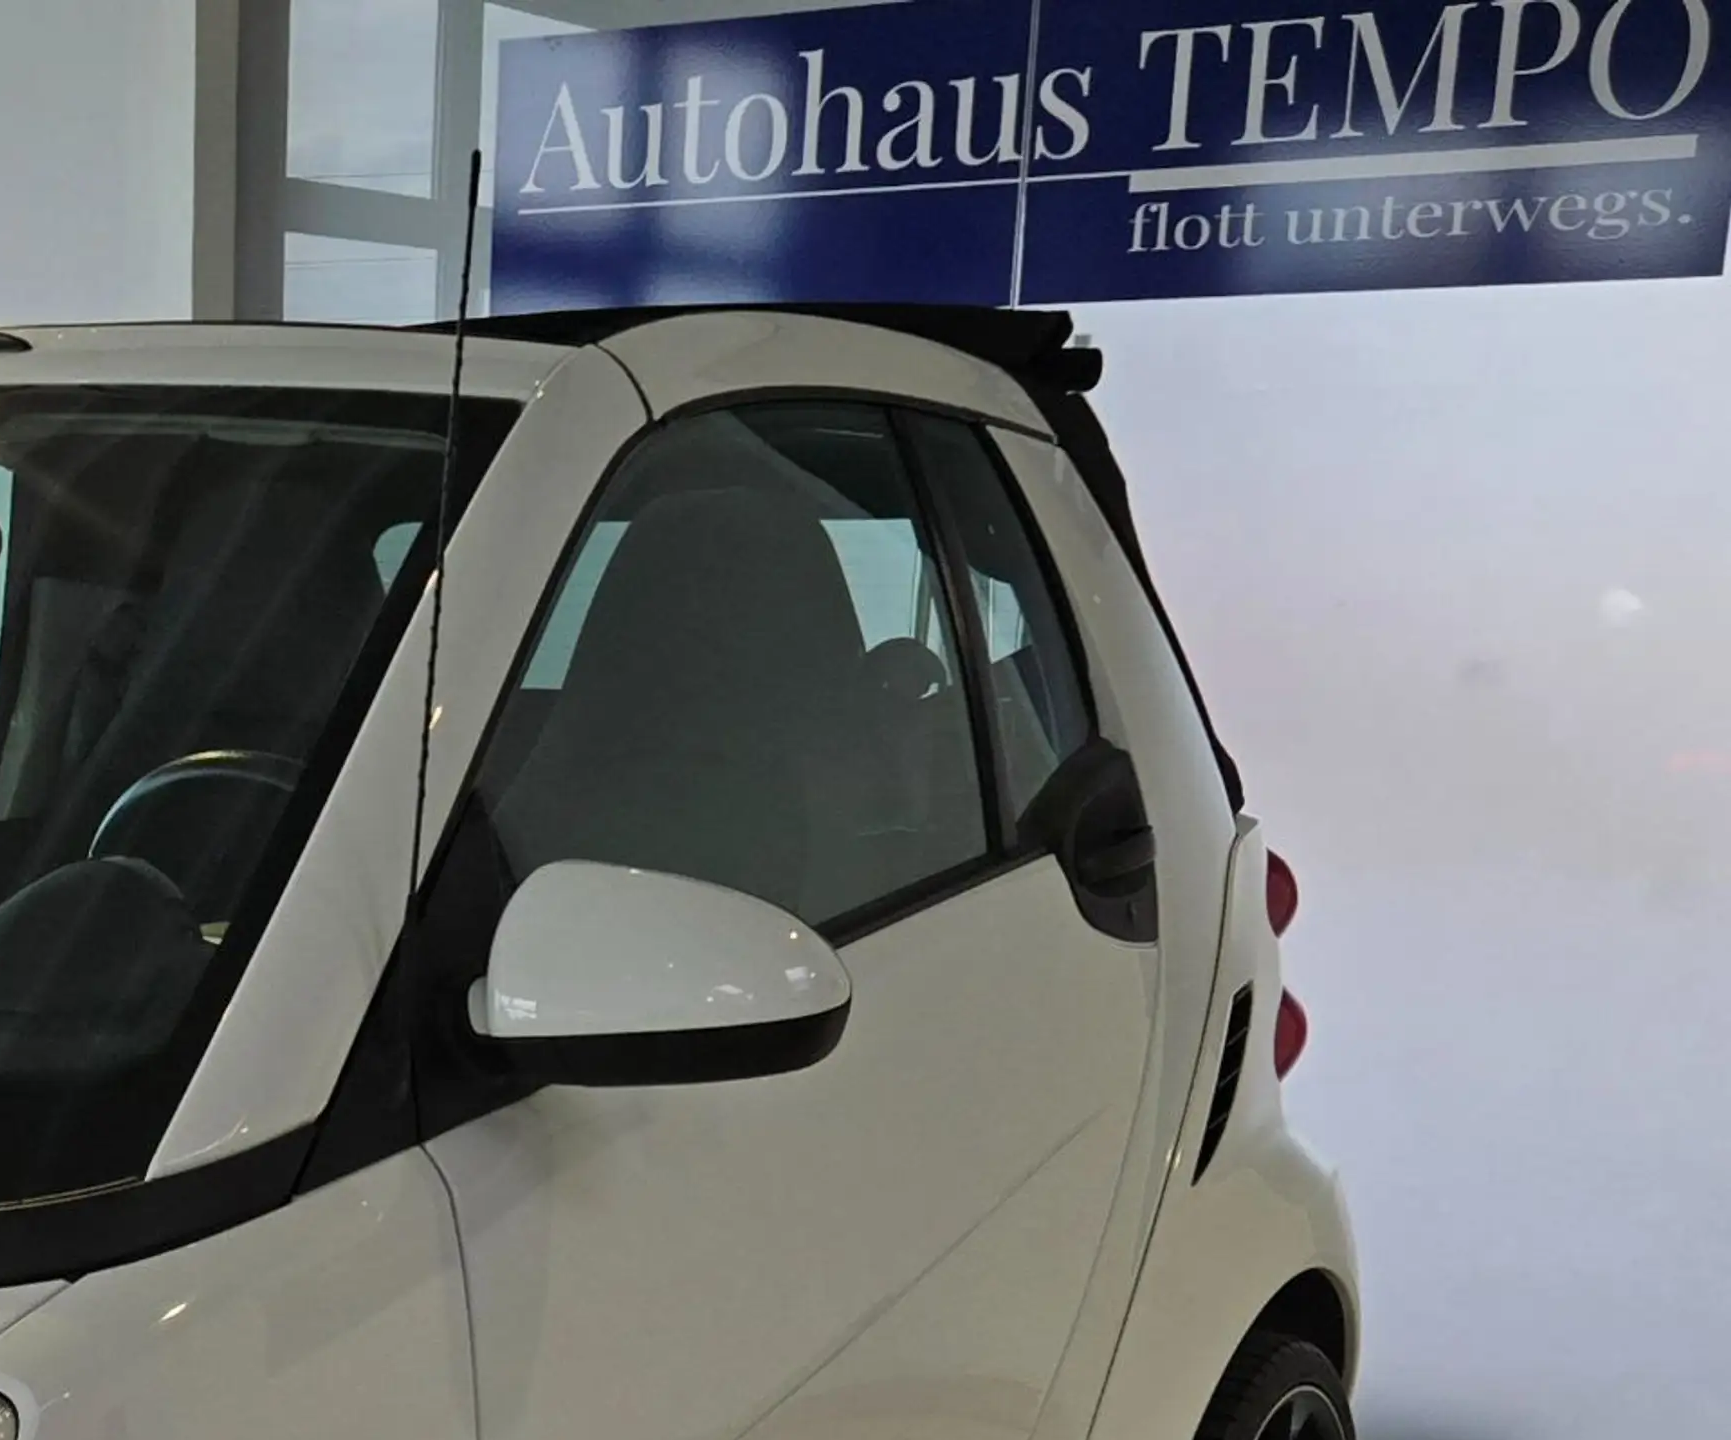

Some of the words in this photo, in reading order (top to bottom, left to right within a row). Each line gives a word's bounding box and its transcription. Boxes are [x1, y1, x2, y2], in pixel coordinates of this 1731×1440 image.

[520, 49, 1092, 193] Autohaus
[1140, 0, 1710, 152] TEMPO
[1127, 202, 1265, 253] flott
[1286, 187, 1693, 246] unterwegs.
